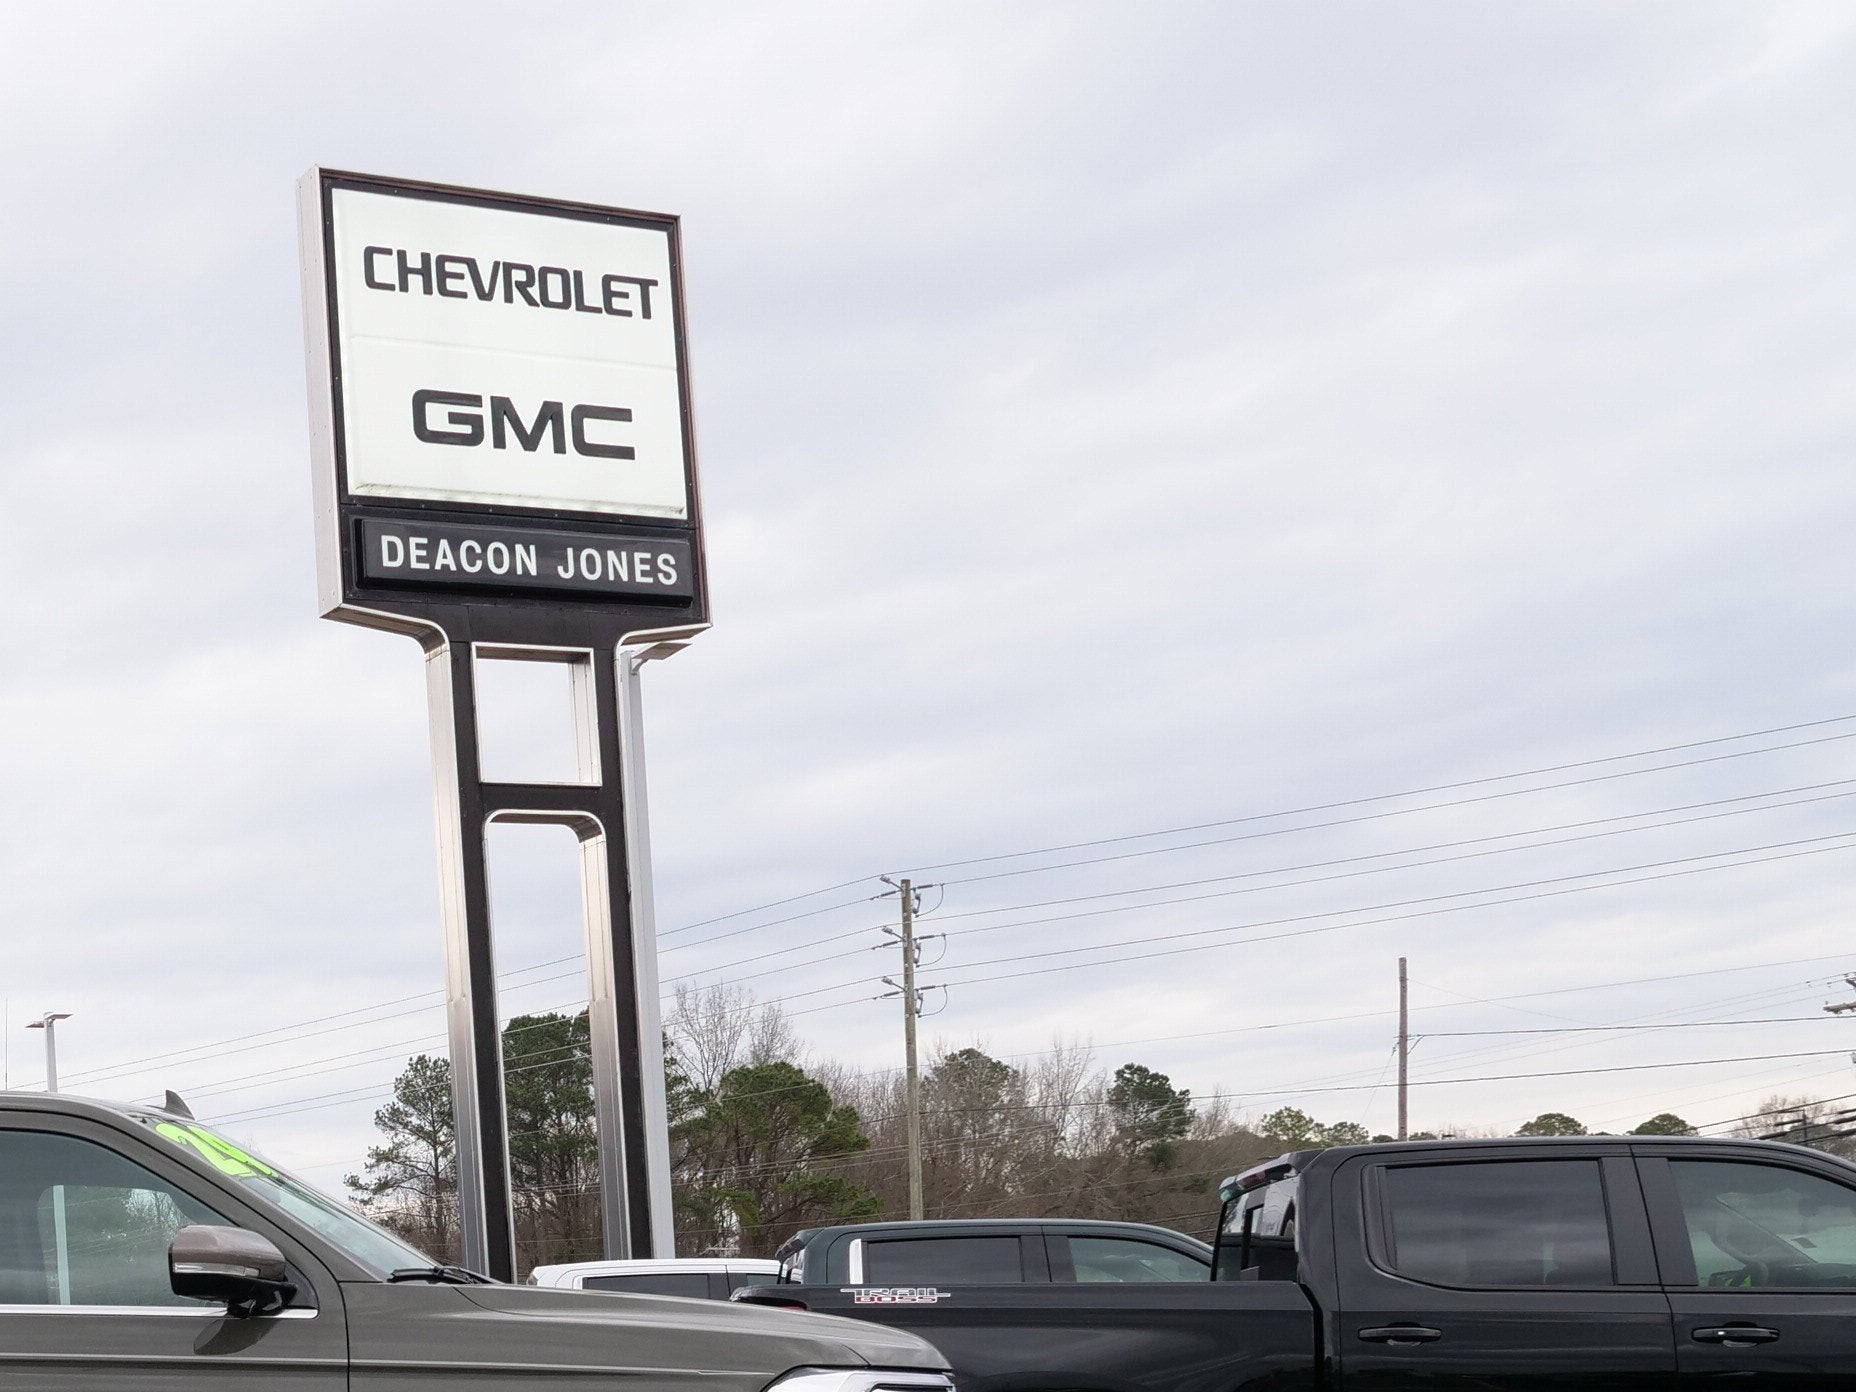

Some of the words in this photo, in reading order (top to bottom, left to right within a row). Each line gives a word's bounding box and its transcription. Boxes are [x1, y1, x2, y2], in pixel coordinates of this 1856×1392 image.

[363, 245, 659, 320] CHEVROLET
[412, 389, 636, 461] GMC
[380, 534, 538, 577] DEACON
[557, 547, 678, 586] JONES
[840, 1287, 951, 1298] TRAIL
[854, 1295, 937, 1304] BOSS
